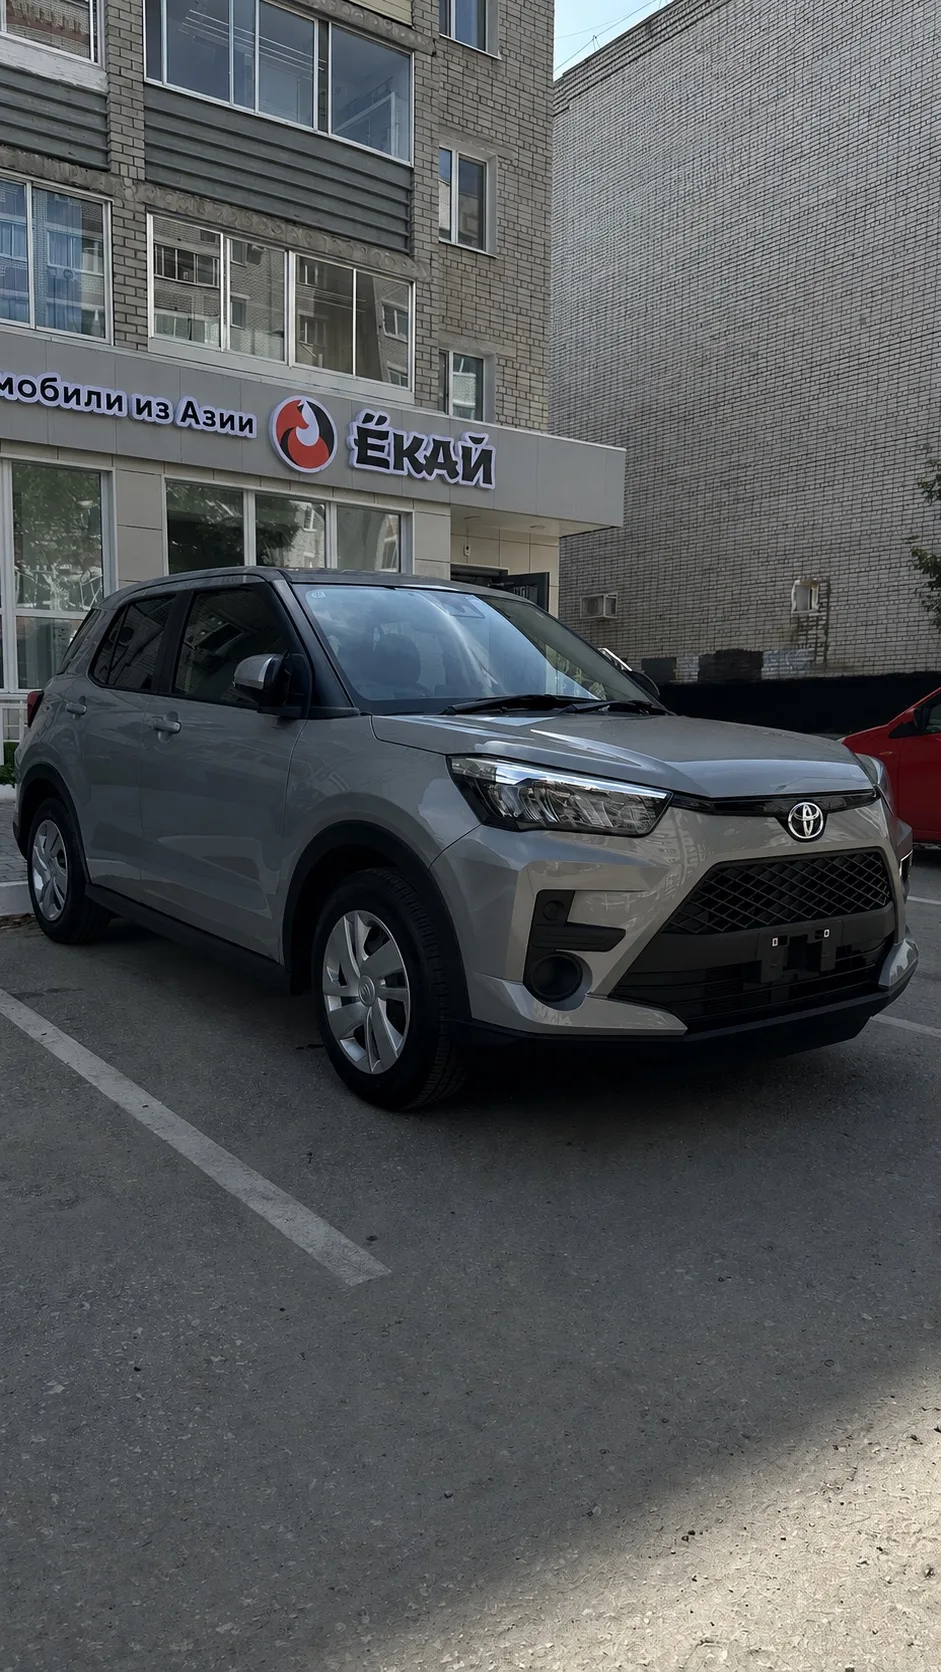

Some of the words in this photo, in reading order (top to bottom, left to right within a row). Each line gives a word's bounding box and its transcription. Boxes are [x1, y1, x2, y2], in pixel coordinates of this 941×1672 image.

[135, 398, 170, 420] из
[180, 400, 254, 434] Азии
[353, 412, 494, 485] ЁКАЙ
